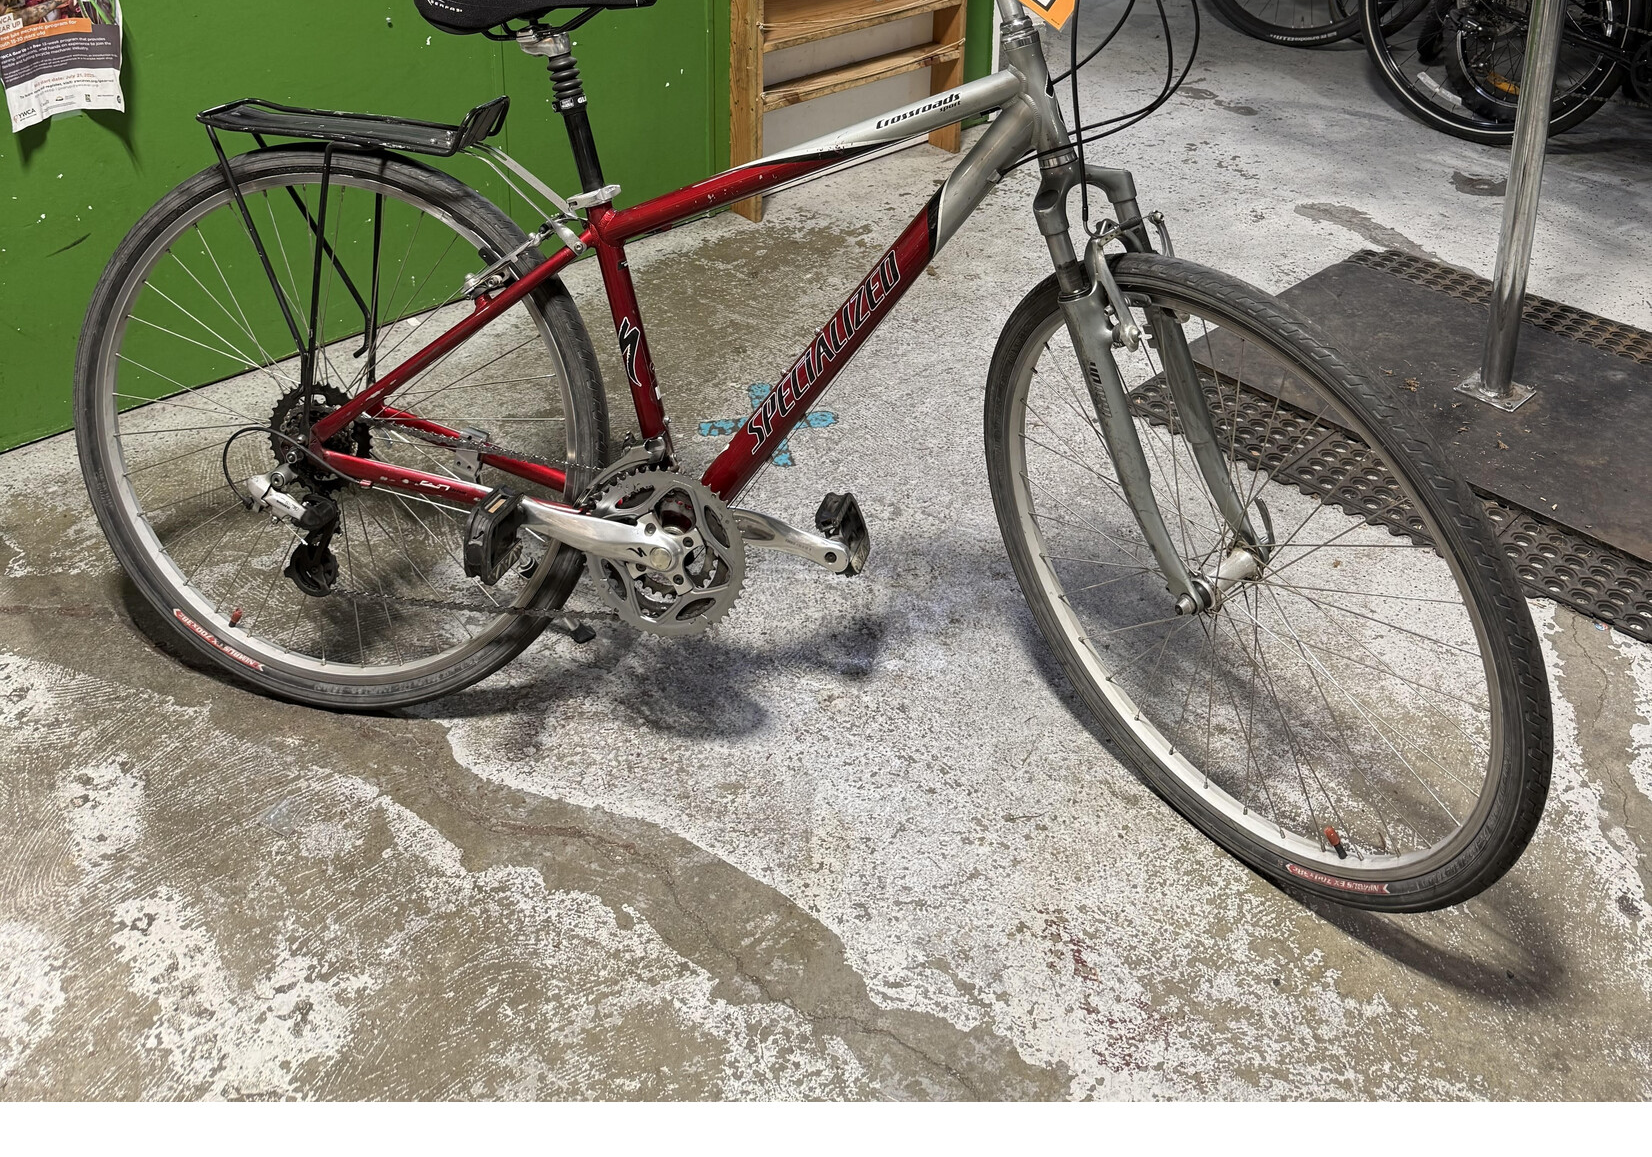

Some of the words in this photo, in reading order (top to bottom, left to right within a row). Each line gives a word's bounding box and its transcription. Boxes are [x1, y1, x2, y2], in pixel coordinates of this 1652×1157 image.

[13, 21, 22, 29] UP
[21, 25, 44, 34] mechanic
[44, 21, 68, 30] program
[19, 108, 36, 118] YWCA
[875, 92, 961, 130] Crossroads
[939, 100, 961, 113] sport
[747, 249, 901, 455] SPECIALIZED
[223, 644, 257, 666] NIMBUS
[1347, 882, 1380, 892] NIMBUS
